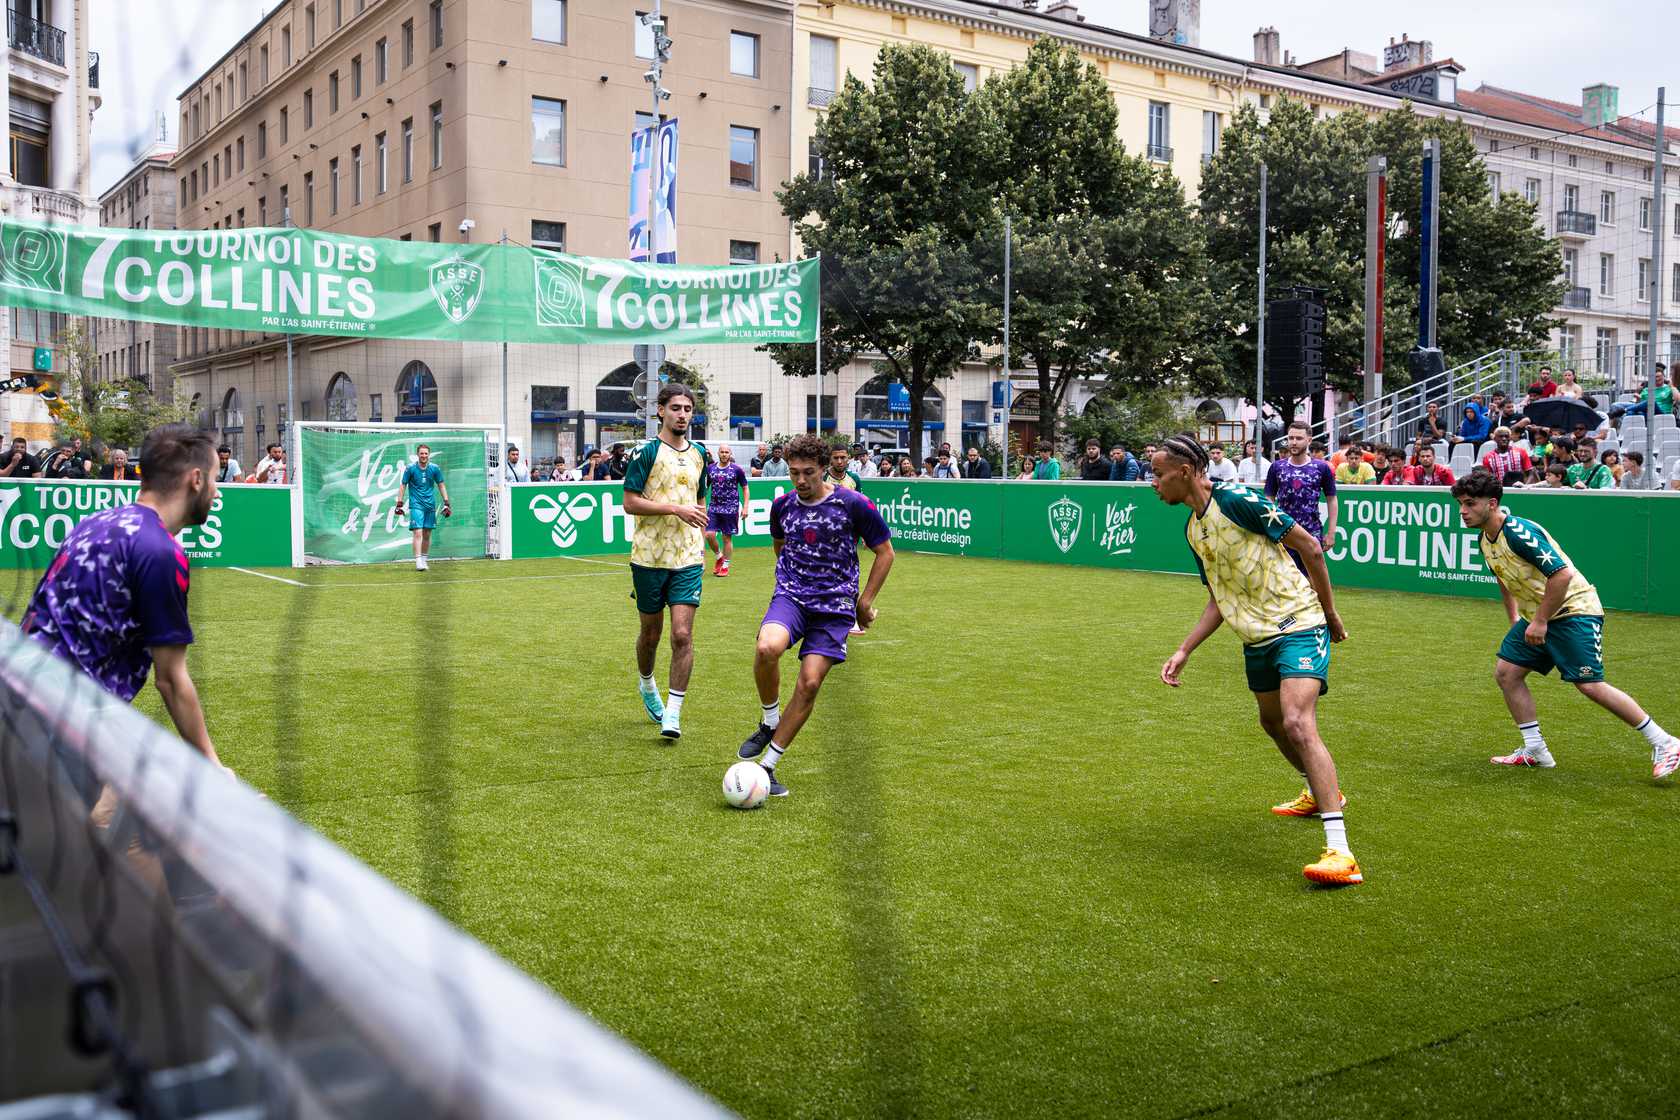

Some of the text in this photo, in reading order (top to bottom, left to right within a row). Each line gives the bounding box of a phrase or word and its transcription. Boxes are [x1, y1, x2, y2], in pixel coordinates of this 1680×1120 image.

[150, 230, 377, 272] TOURNOI DES
[73, 232, 128, 299] 7
[437, 267, 478, 282] ASSE
[759, 264, 801, 288] DES
[114, 257, 376, 319] COLLINES
[586, 263, 628, 328] 7
[617, 290, 802, 330] COLLINES
[261, 316, 366, 331] PAR L'AS SAINT-ÉTIENNE
[34, 487, 140, 510] TOURN
[1053, 507, 1078, 519] ASSE
[1106, 501, 1138, 528] Vert
[1344, 499, 1451, 528] TOURNOI
[904, 528, 939, 542] créative
[941, 531, 971, 548] design
[1107, 524, 1138, 550] Fier
[1327, 526, 1491, 571] COLLINE
[1419, 569, 1432, 578] PAR
[1433, 571, 1447, 579] L'AS
